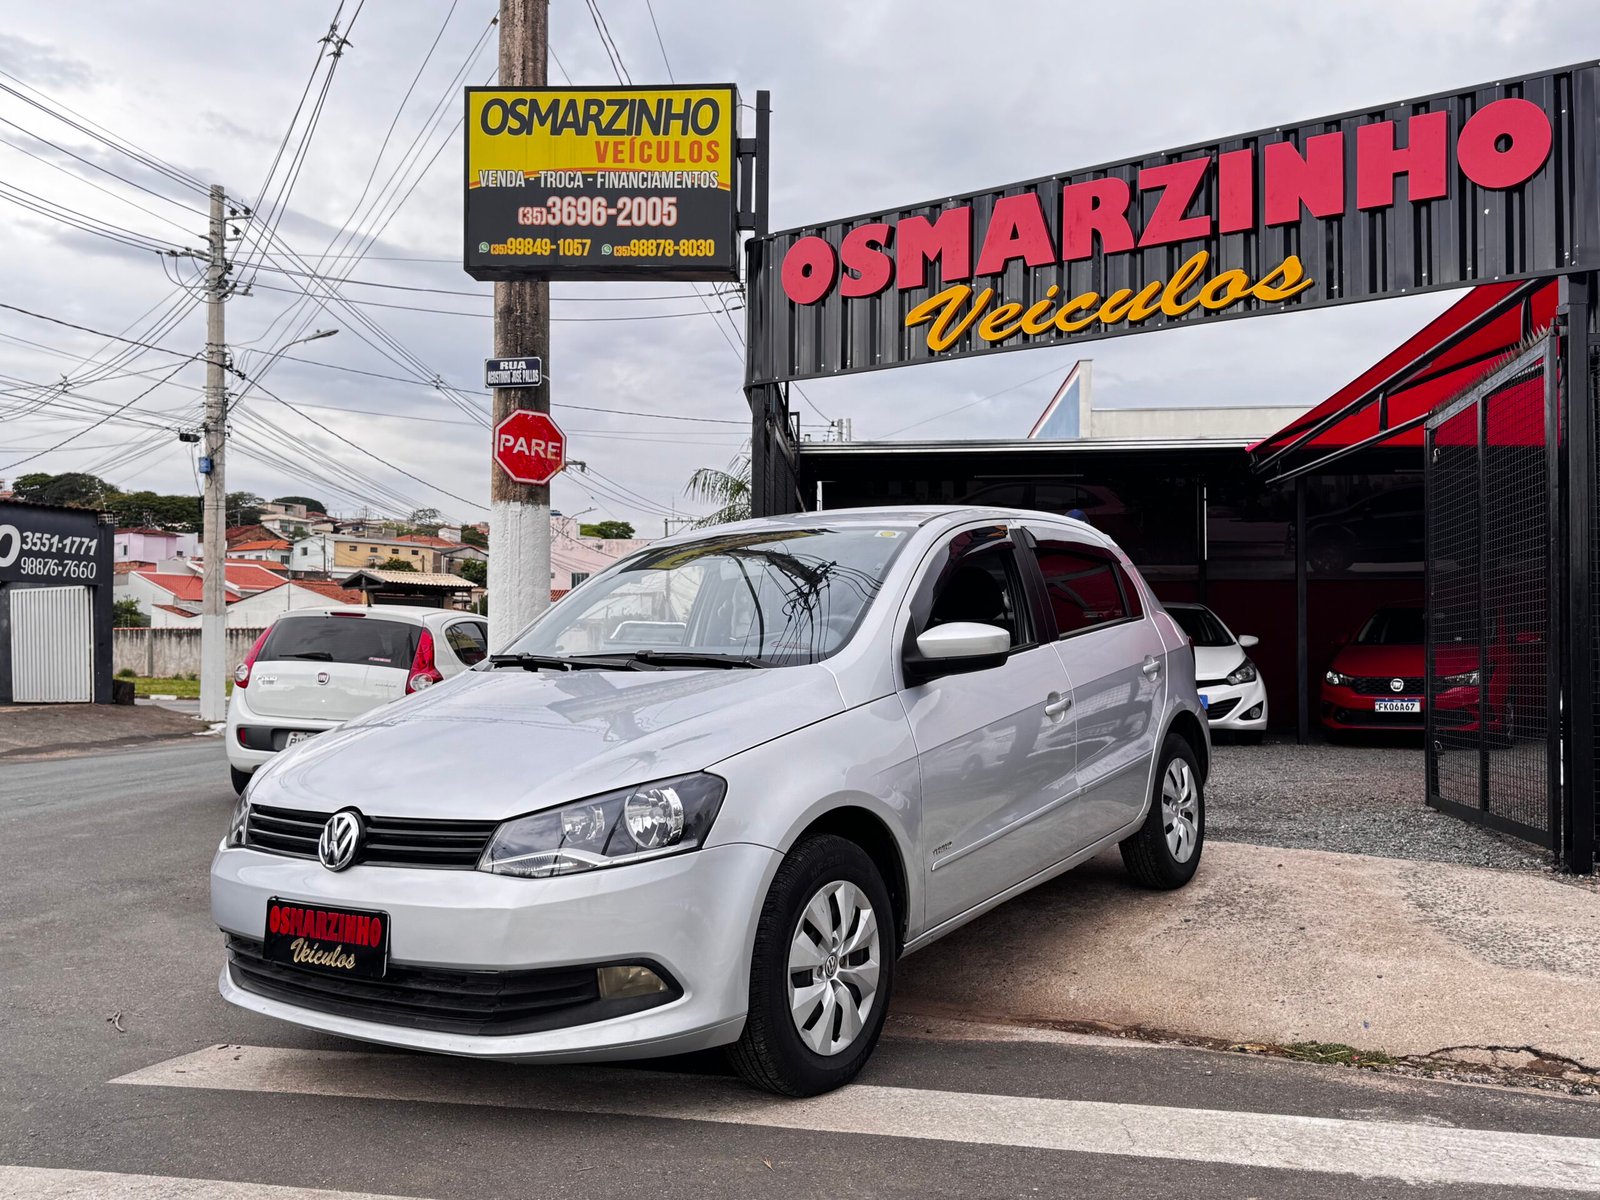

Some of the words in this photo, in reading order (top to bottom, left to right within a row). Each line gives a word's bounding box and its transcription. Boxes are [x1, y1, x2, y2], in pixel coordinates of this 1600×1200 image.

[480, 97, 720, 136] OSMARZINHO
[595, 137, 720, 164] VEÍCULOS
[479, 170, 525, 188] VENDA
[539, 170, 583, 188] TROCA
[597, 170, 718, 189] FINANCIAMENTOS
[781, 97, 1552, 305] OSMARZINHO
[500, 361, 527, 370] RUA
[500, 434, 560, 460] PARE
[269, 905, 382, 948] OSMARZINHO
